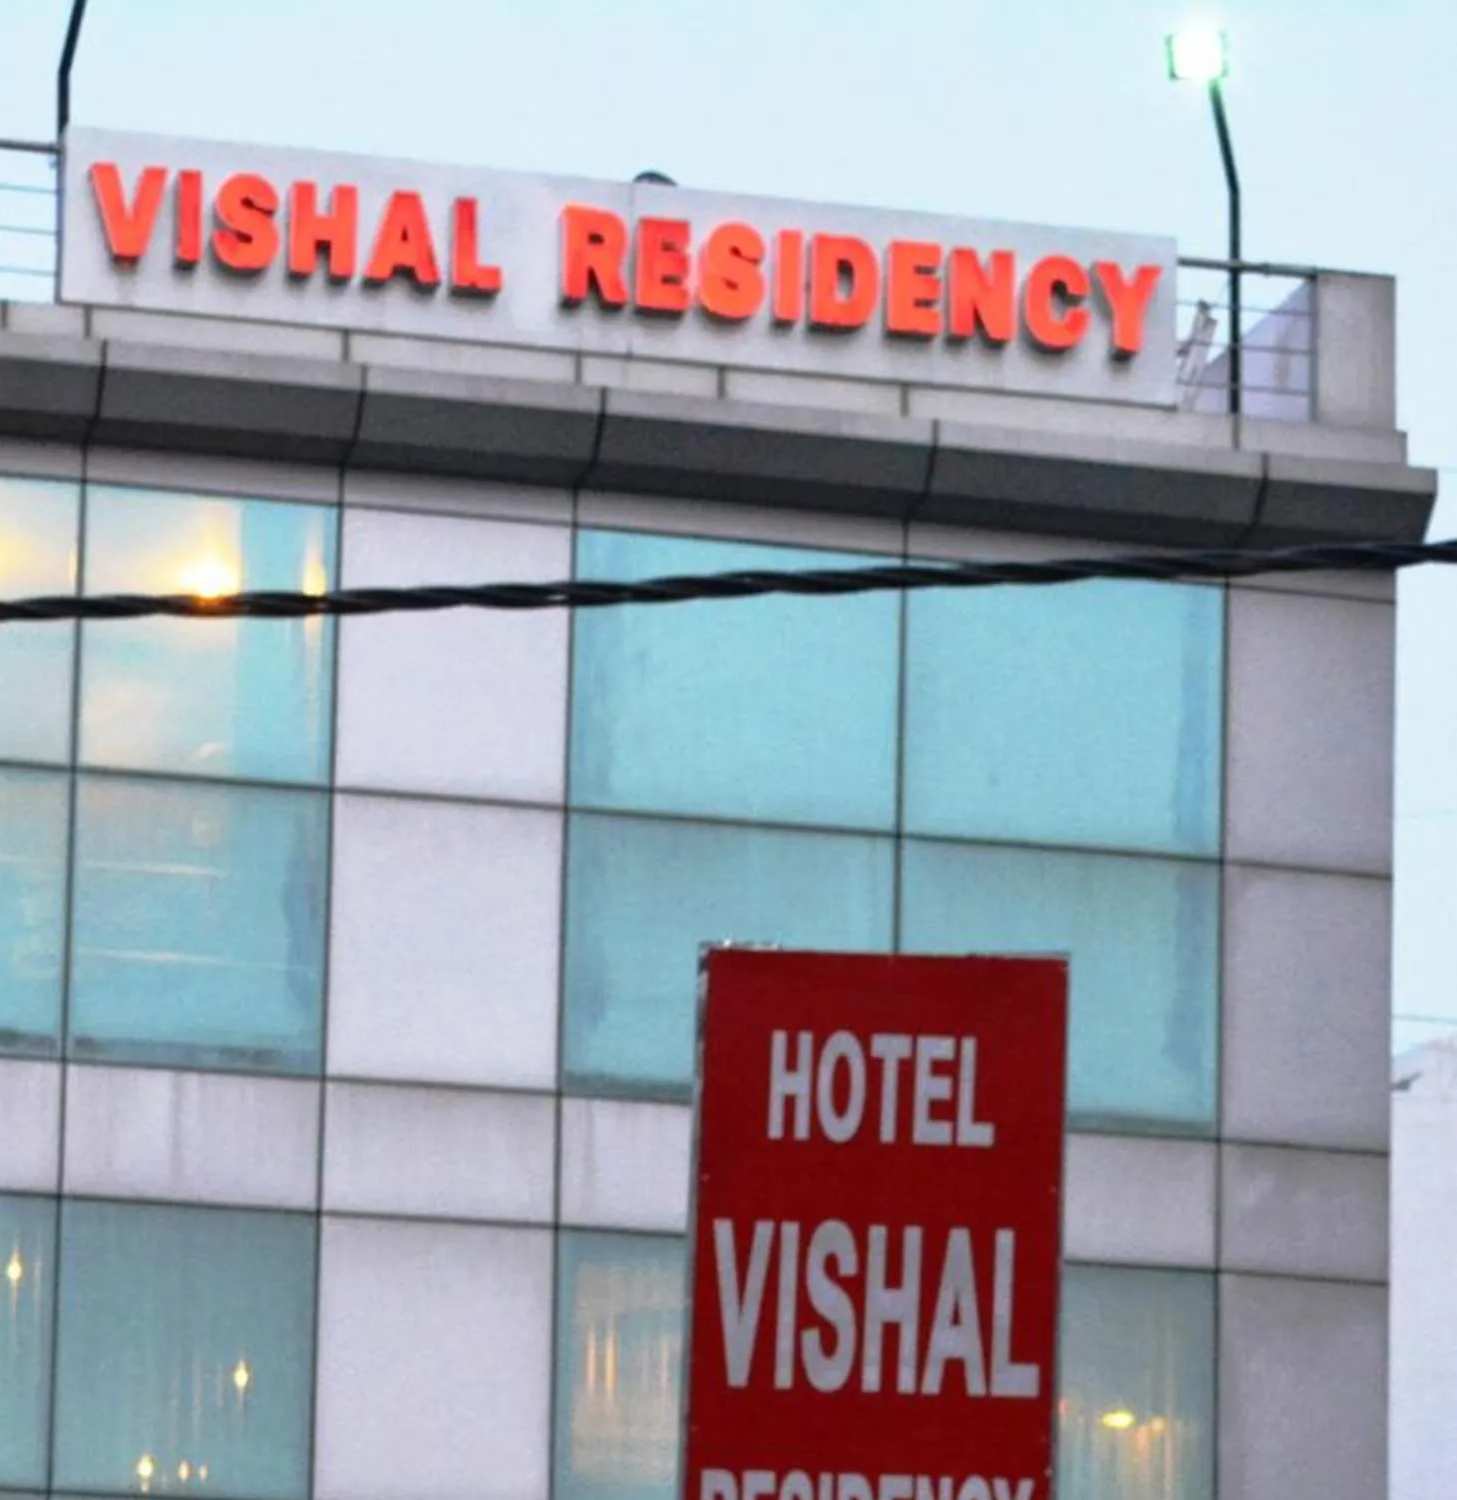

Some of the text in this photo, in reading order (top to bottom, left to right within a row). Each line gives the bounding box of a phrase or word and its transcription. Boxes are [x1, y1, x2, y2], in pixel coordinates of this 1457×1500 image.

[90, 162, 1161, 354] VISHAL RESIDENCY
[767, 1030, 995, 1147] HOTEL
[713, 1218, 1041, 1398] VISHAL
